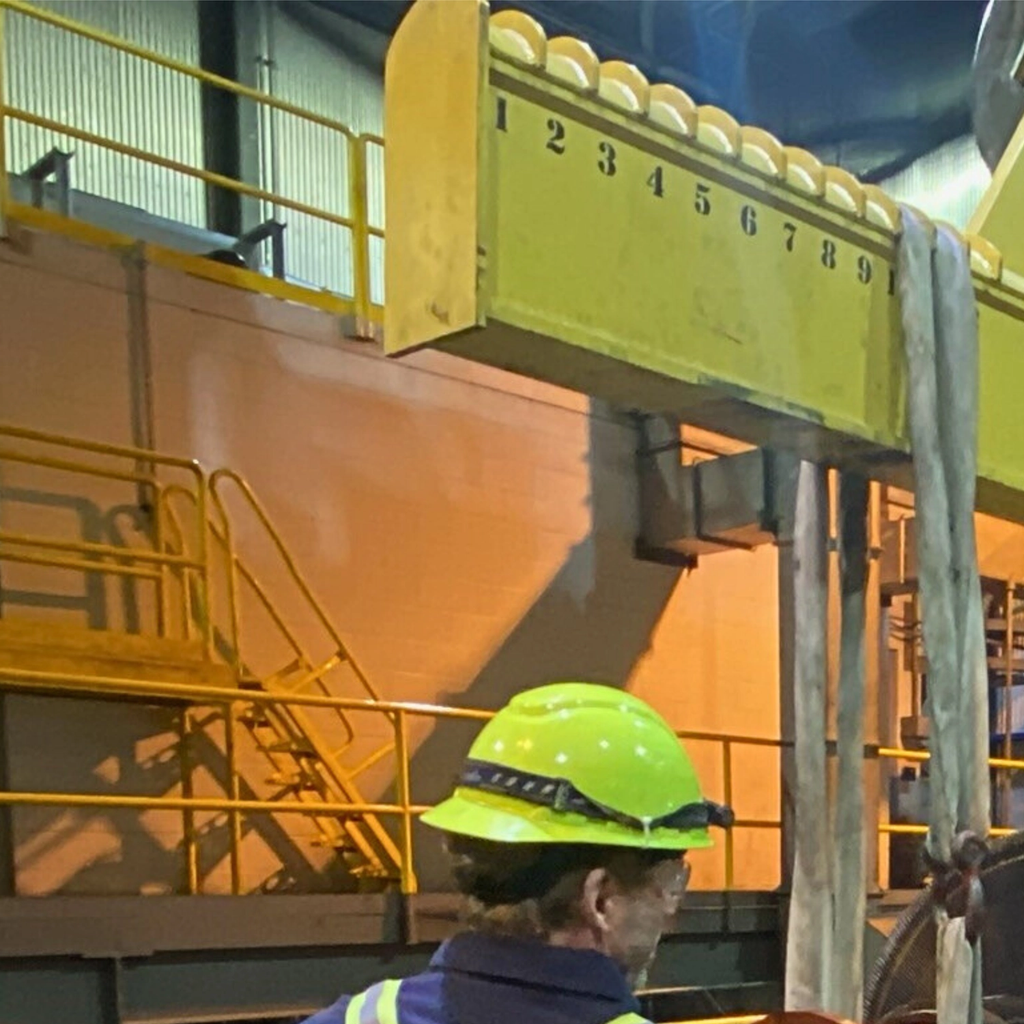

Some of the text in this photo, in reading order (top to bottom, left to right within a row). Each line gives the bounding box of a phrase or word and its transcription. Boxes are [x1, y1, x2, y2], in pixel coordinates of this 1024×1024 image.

[496, 96, 508, 133] 1
[546, 118, 566, 155] 2
[597, 141, 617, 177] 3
[646, 165, 663, 199] 4
[694, 182, 711, 216] 5
[740, 204, 758, 237] 6
[783, 222, 797, 253] 7
[821, 238, 837, 270] 8
[857, 254, 873, 285] 9
